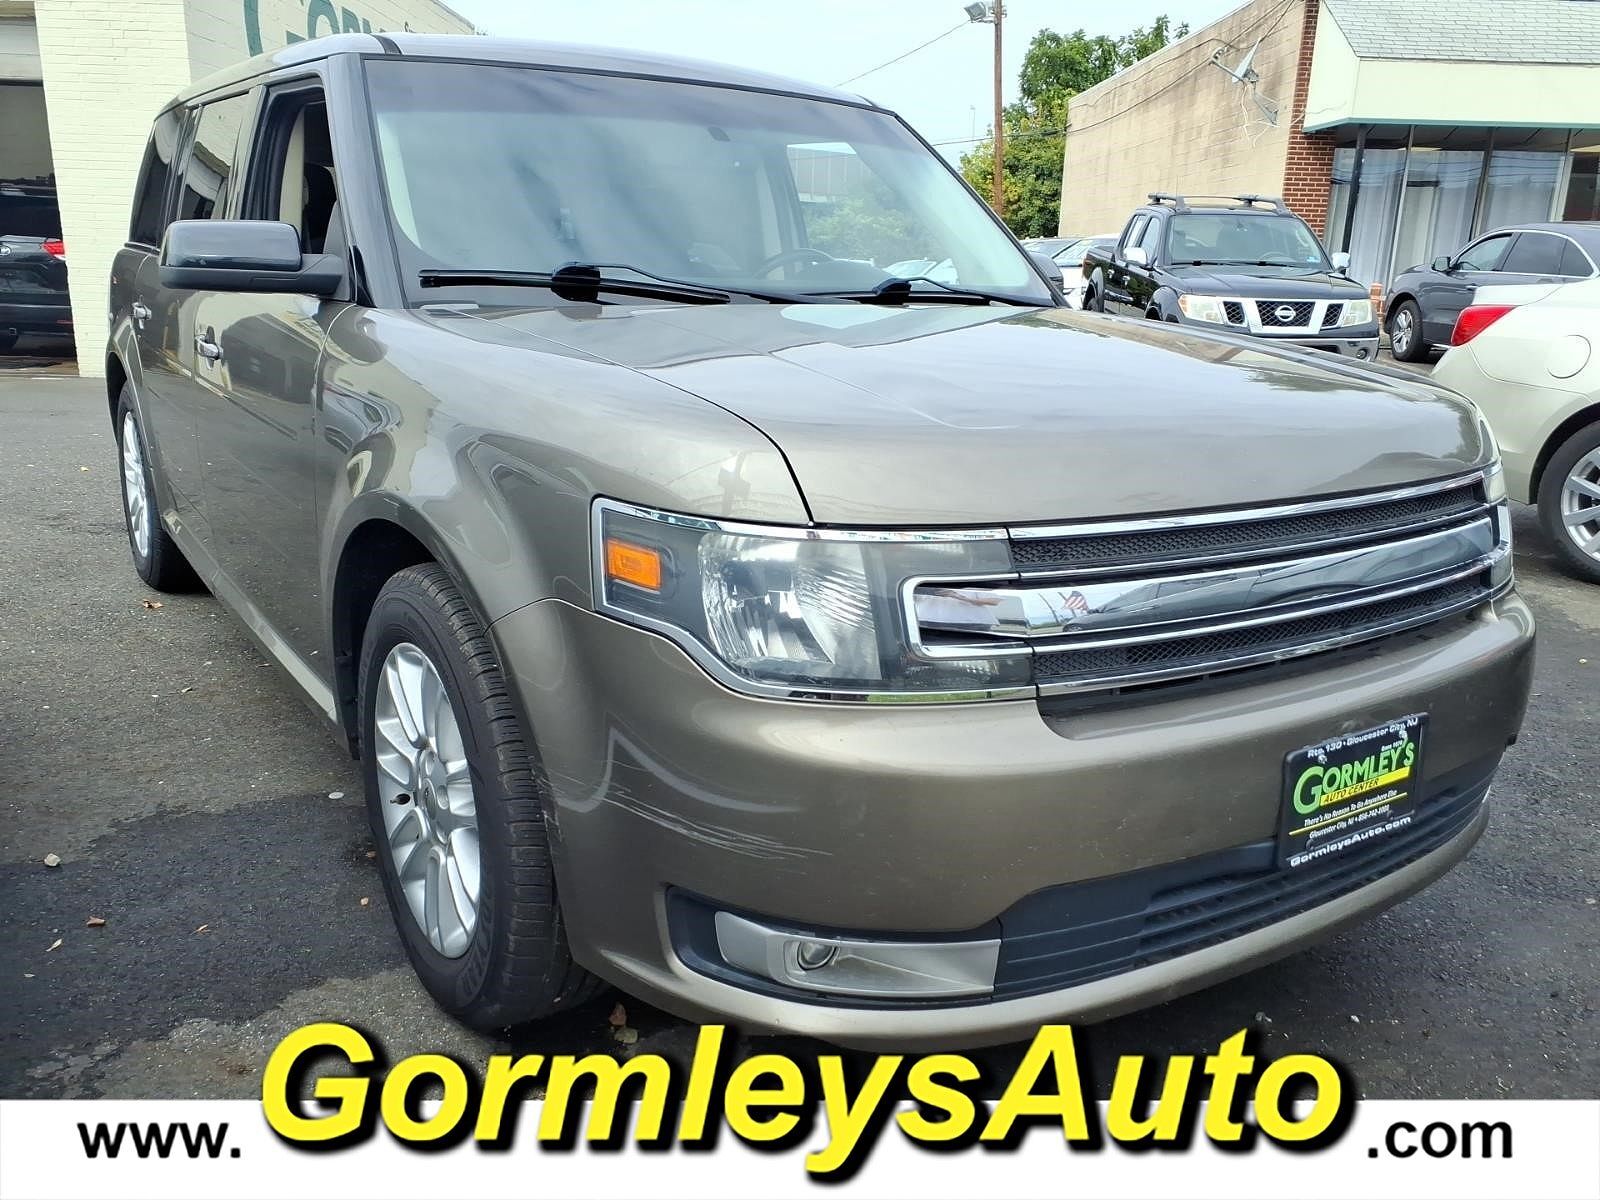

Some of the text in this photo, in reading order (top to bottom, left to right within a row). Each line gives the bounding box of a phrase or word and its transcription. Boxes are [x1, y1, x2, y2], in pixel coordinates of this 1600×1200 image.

[1326, 740, 1342, 752] 130
[1346, 728, 1389, 746] Gloucester
[1407, 717, 1418, 728] NJ
[1293, 739, 1416, 815] GORMLEY'S
[1324, 777, 1380, 802] AUTO CENTER
[1290, 816, 1411, 867] GormleysAuto.com
